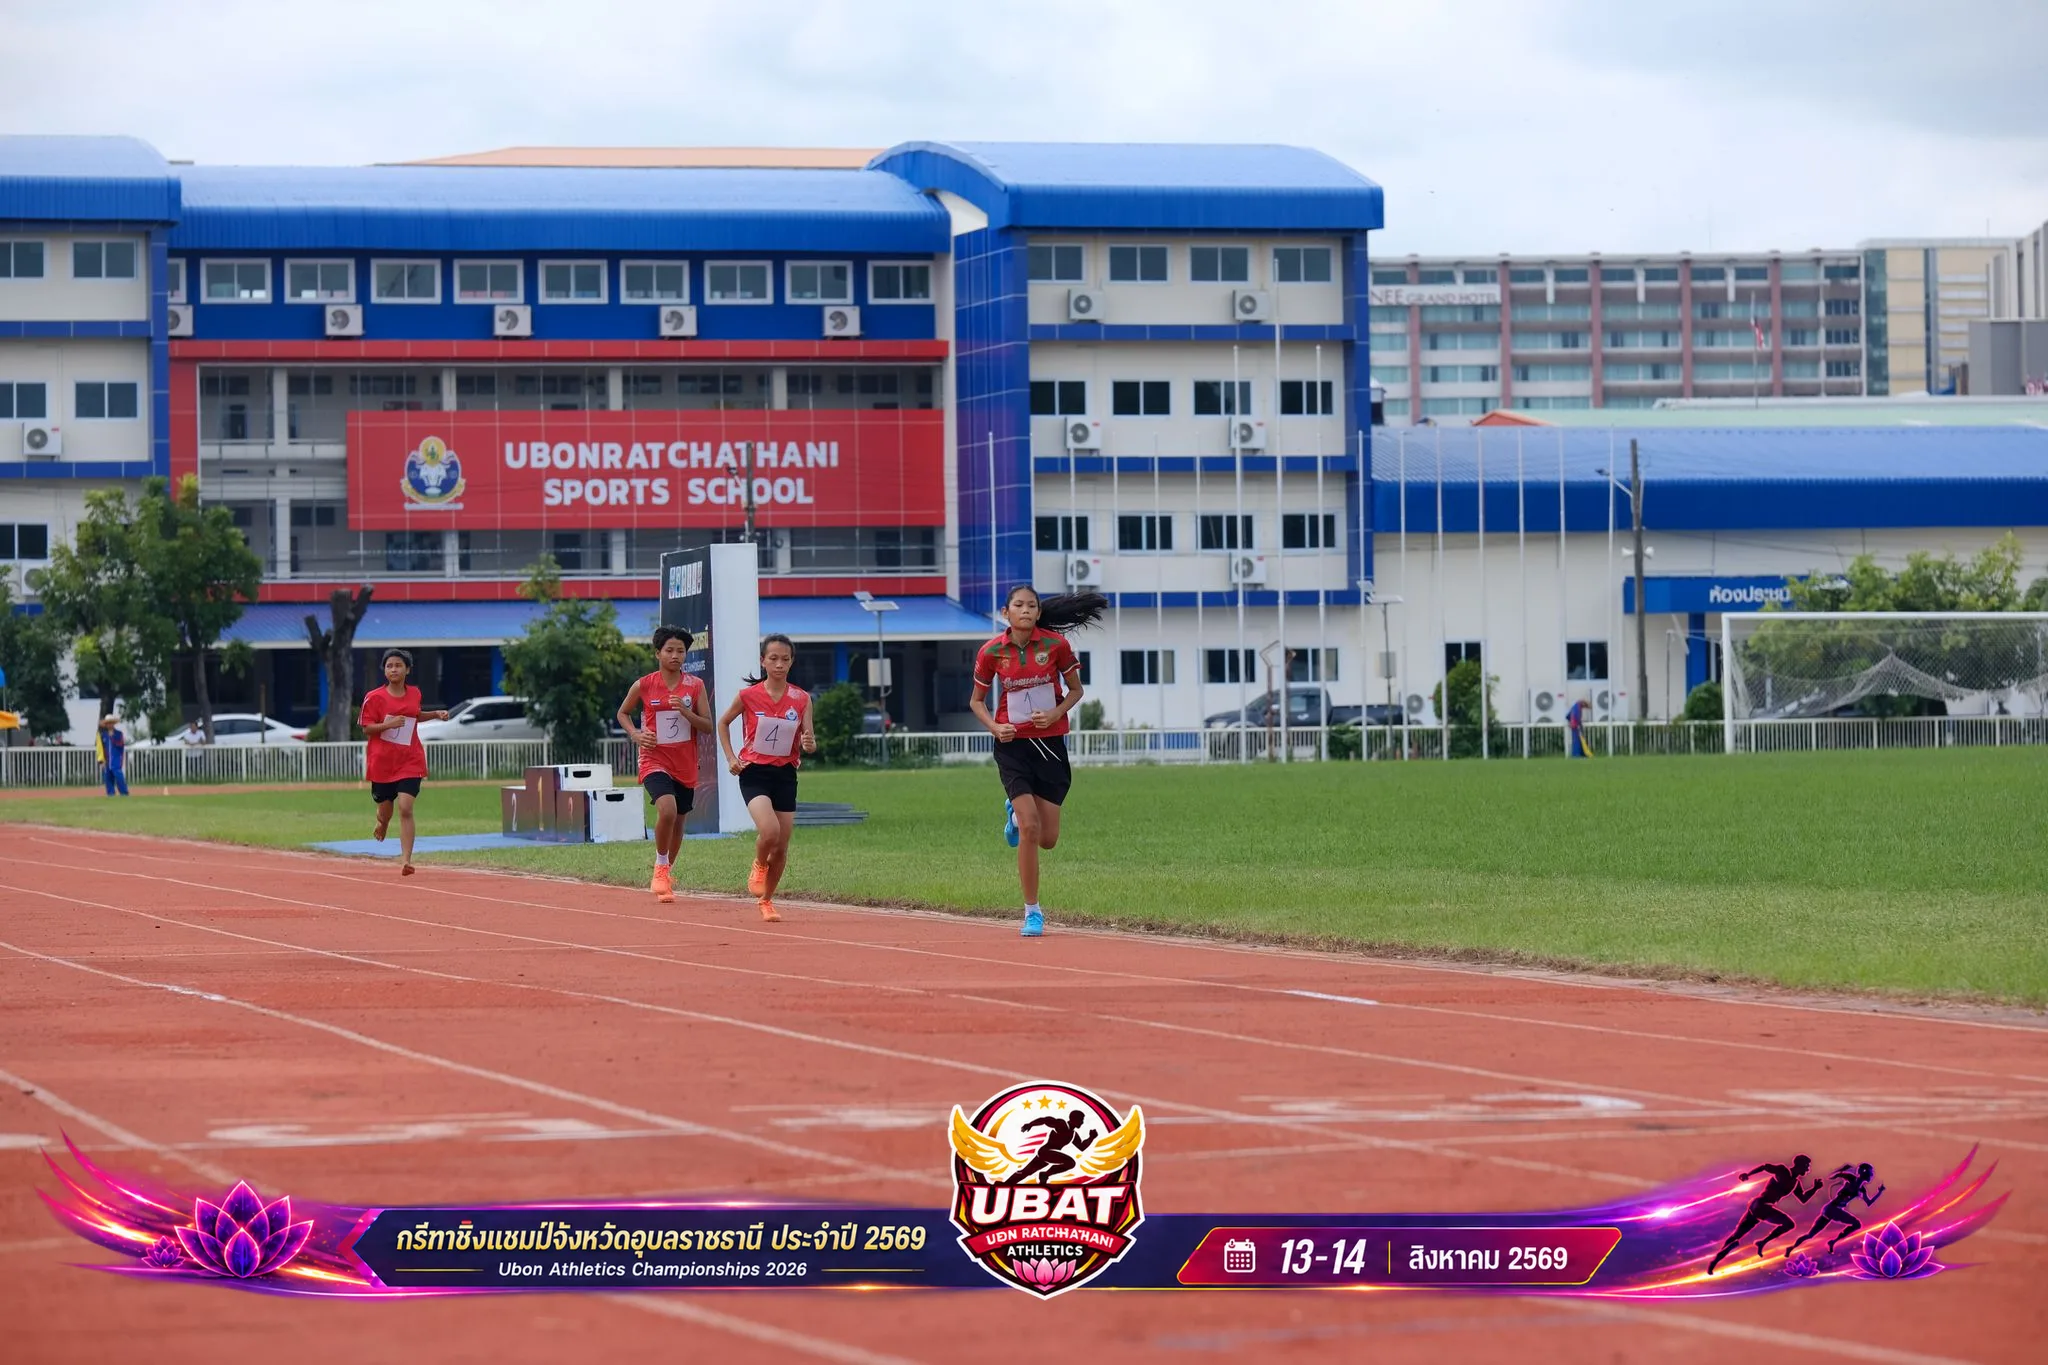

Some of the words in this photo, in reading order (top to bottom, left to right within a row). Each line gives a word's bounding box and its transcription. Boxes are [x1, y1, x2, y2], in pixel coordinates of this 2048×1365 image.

[504, 440, 839, 469] UBONRATCHATHANI
[543, 477, 670, 506] SPORTS
[688, 476, 814, 505] SCHOOL
[665, 716, 680, 739] 3
[764, 723, 780, 750] 4
